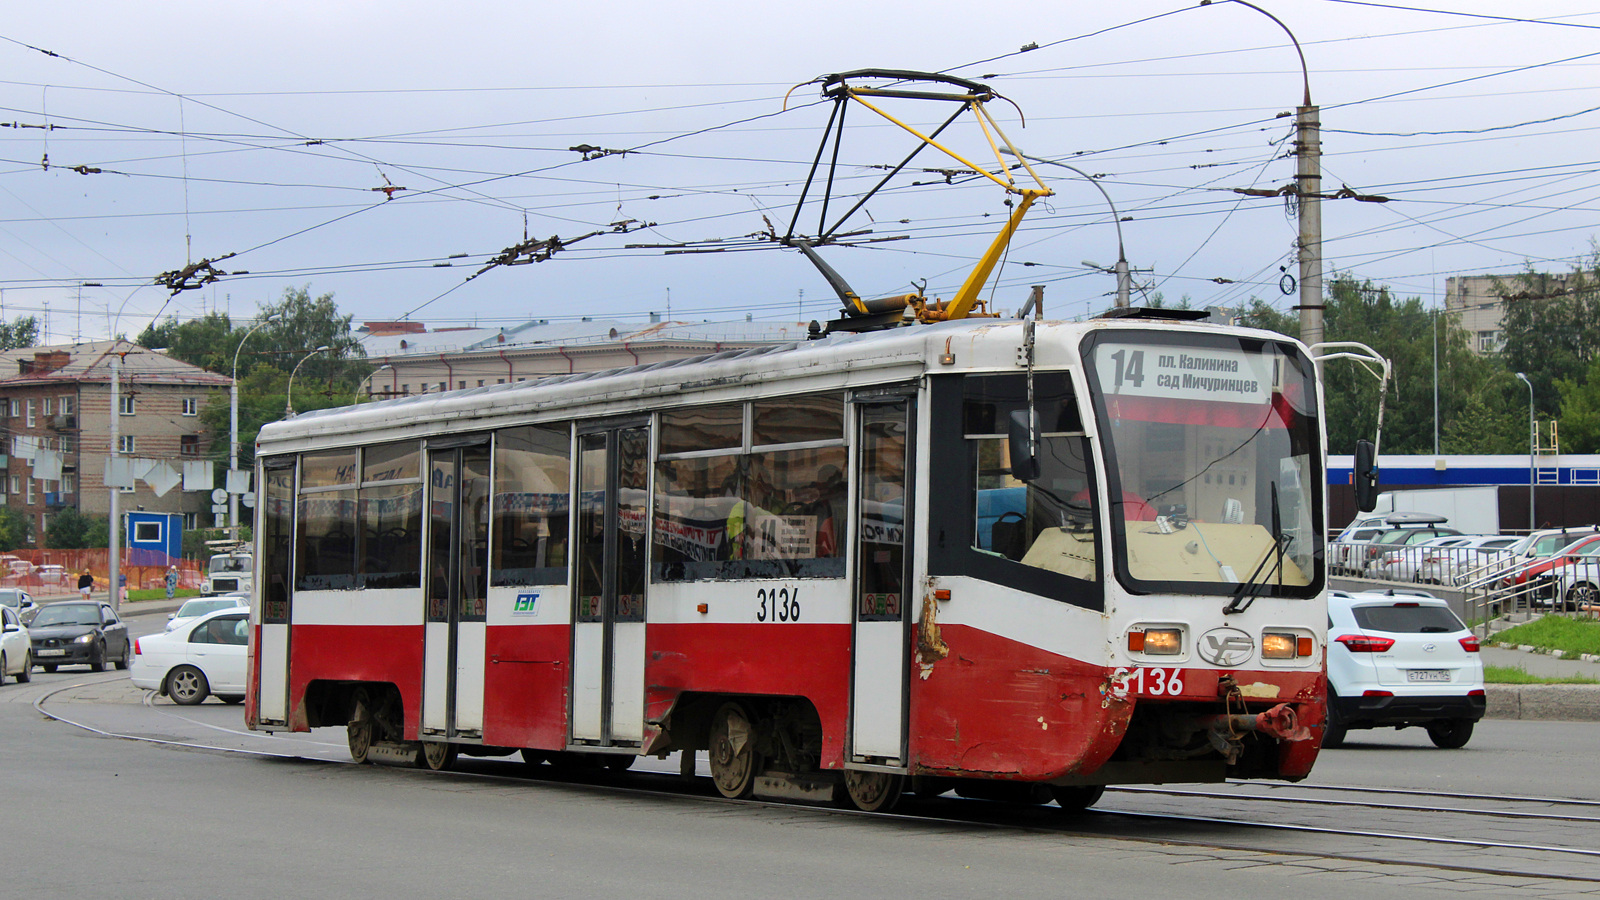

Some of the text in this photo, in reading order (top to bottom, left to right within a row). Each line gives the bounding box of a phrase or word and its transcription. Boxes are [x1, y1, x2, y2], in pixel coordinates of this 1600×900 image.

[1110, 349, 1145, 388] 14
[1158, 354, 1239, 373] пл. Калинина
[1156, 375, 1258, 394] сад Мичуринцев
[761, 519, 776, 552] 14
[756, 587, 801, 622] 3136
[1112, 667, 1184, 697] 3136
